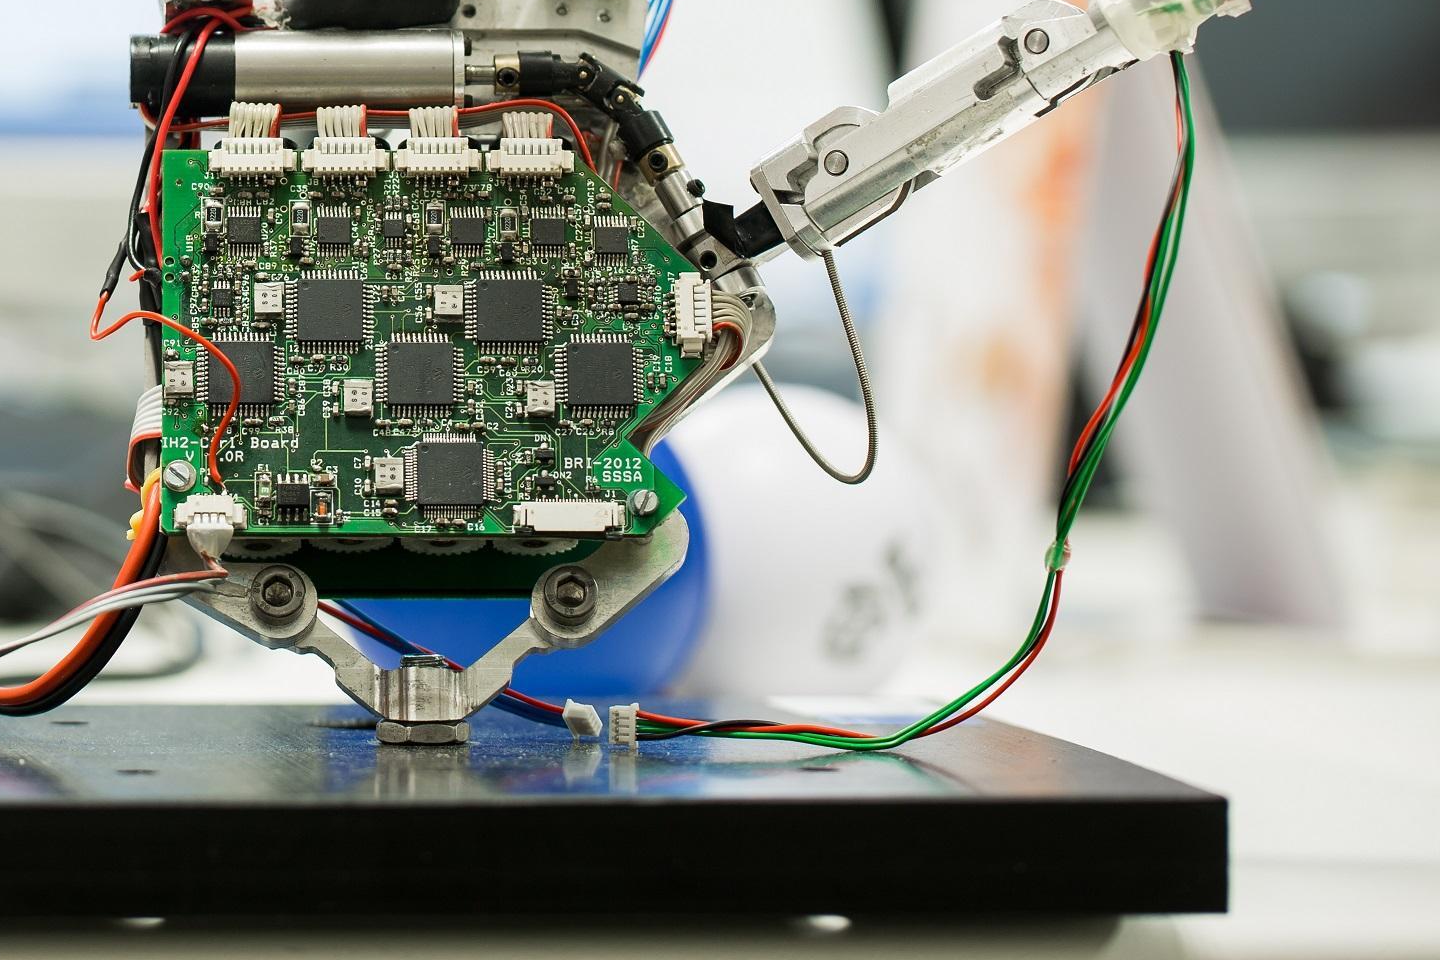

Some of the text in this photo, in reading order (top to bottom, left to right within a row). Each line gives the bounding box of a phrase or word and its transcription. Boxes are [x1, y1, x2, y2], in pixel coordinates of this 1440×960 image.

[270, 240, 278, 257] R37
[162, 408, 179, 416] C92
[505, 401, 513, 418] C24
[486, 423, 499, 431] C2
[576, 428, 594, 436] C26
[534, 434, 551, 442] DN1
[162, 437, 299, 449] IH2-Crl Board
[354, 457, 362, 469] C7
[564, 458, 642, 469] BRI-2012
[326, 465, 338, 474] C3
[553, 471, 572, 479] DN2
[602, 471, 642, 483] SSSA
[354, 478, 362, 495] C10
[604, 490, 616, 498] J1
[363, 500, 380, 508] C14
[467, 523, 485, 531] C16
